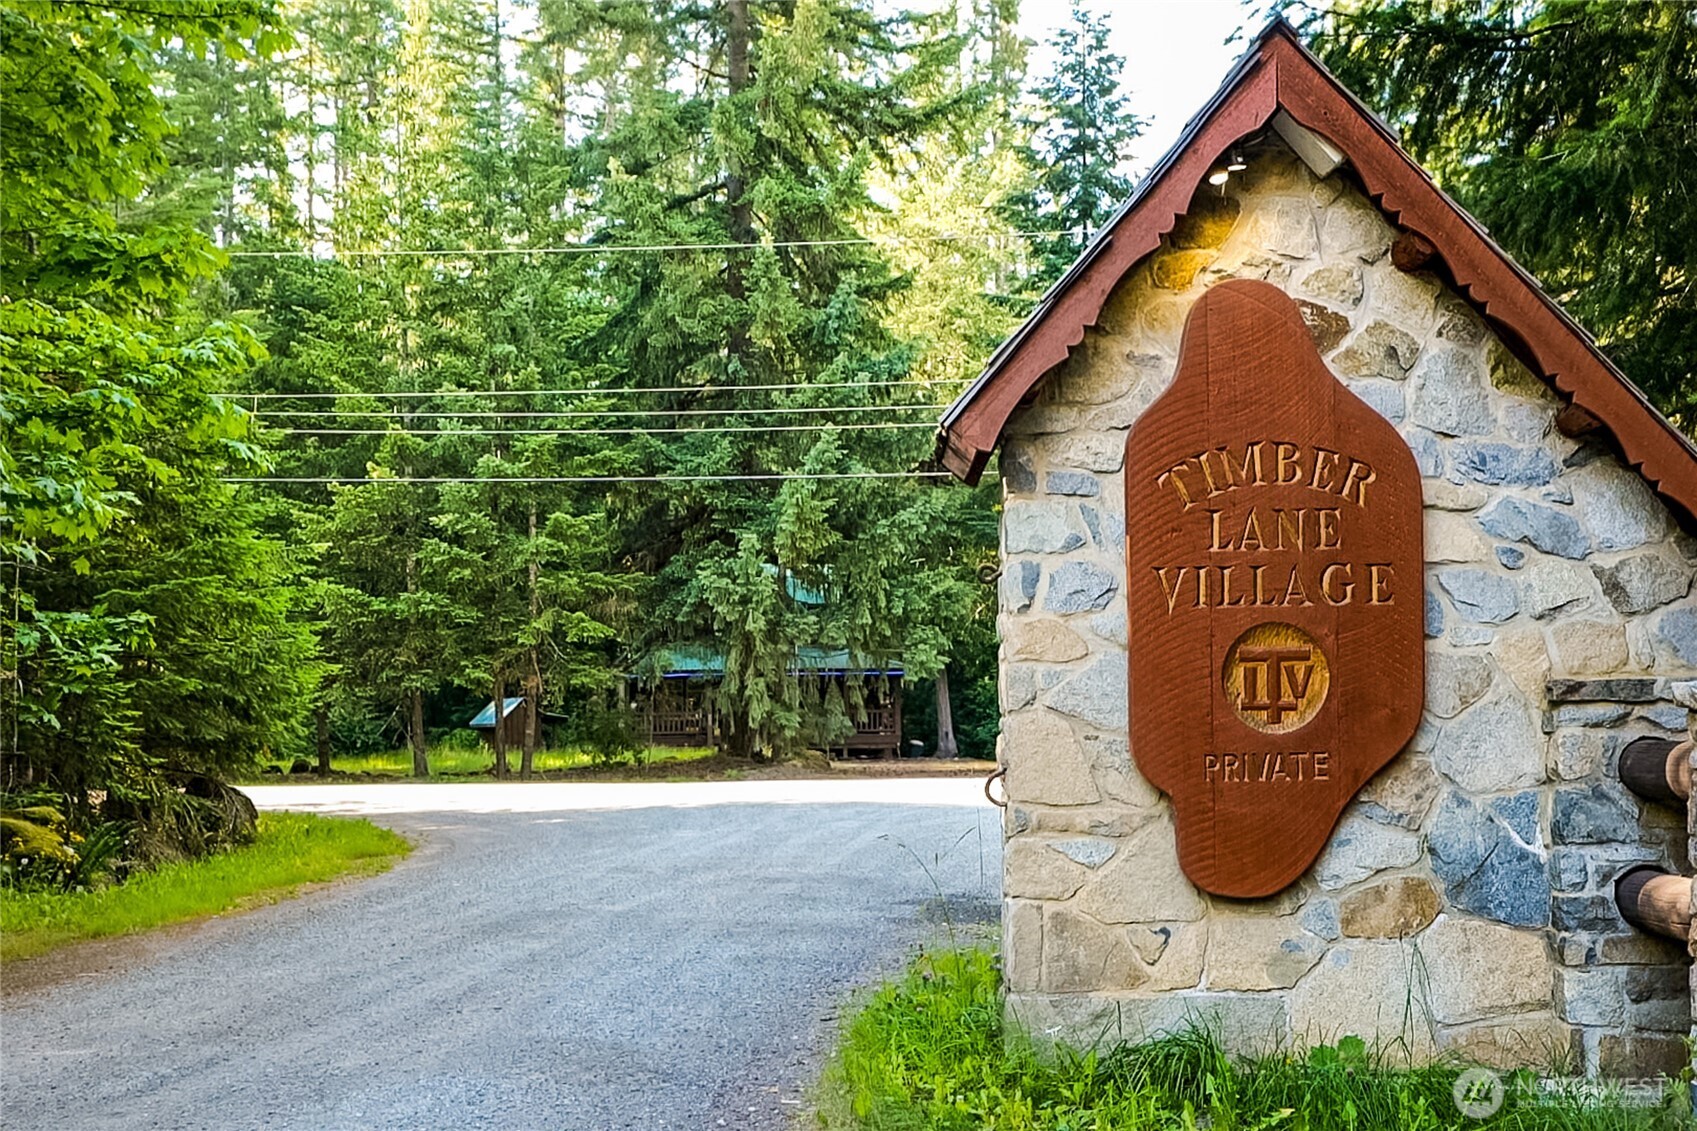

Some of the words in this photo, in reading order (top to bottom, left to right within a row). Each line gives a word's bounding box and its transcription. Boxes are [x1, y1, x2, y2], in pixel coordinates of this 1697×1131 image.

[1155, 440, 1377, 510] TIMBER
[1204, 507, 1342, 552] LANE
[1152, 562, 1395, 615] VILLAGE
[1204, 752, 1330, 782] PRIVATE
